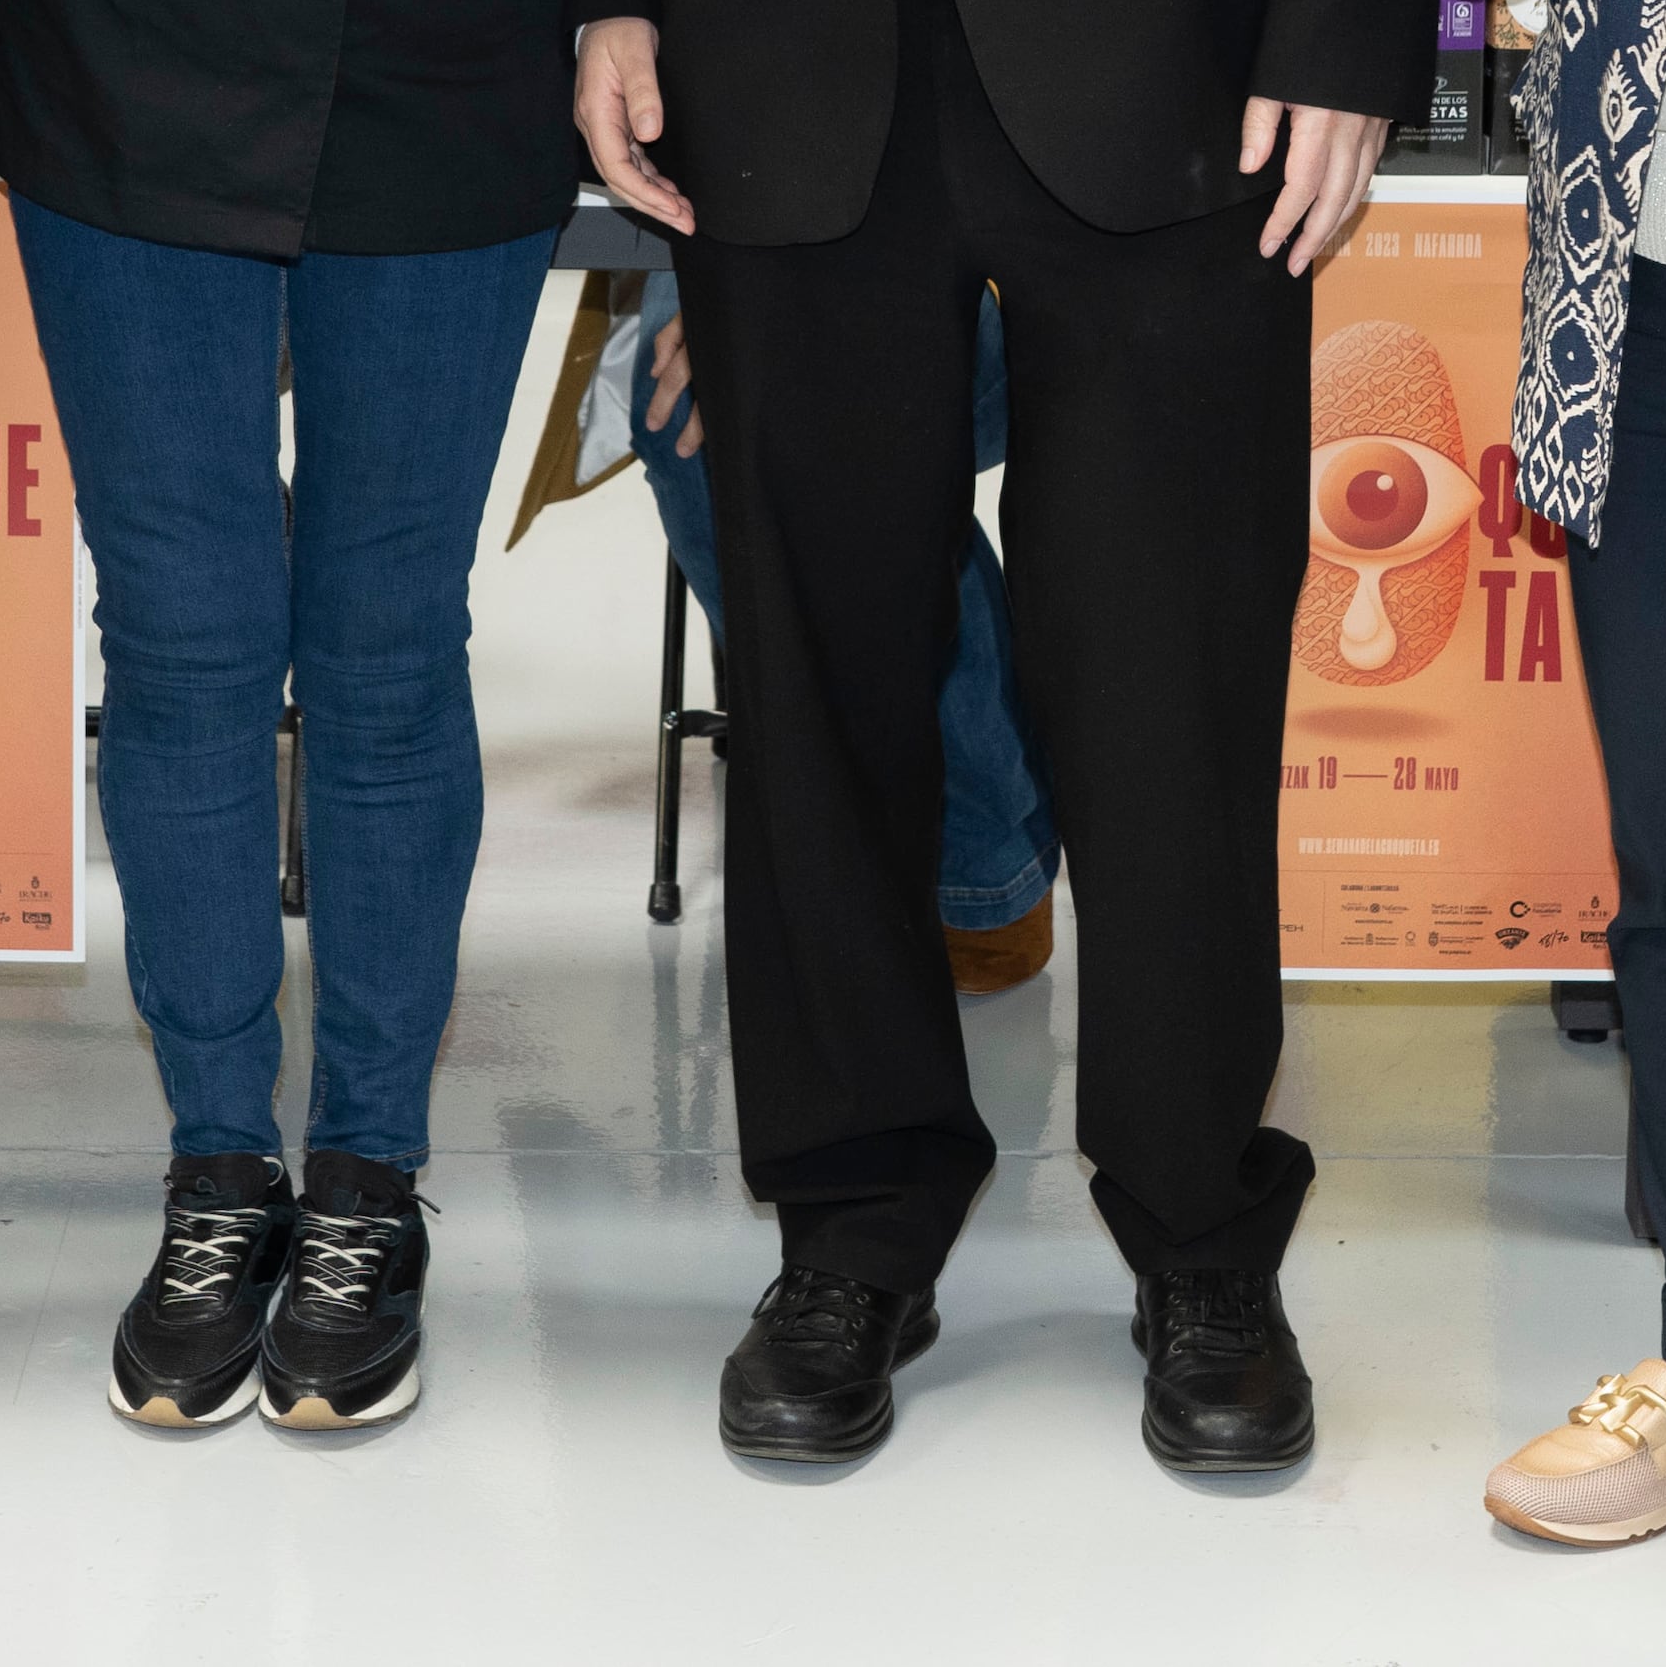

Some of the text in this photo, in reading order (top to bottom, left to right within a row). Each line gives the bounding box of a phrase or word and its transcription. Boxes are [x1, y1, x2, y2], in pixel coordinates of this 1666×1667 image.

[1452, 96, 1468, 104] LOS
[1366, 233, 1482, 258] 2023 NAFARROA
[1479, 570, 1563, 682] TA
[1318, 756, 1459, 791] 19 28 MAYO
